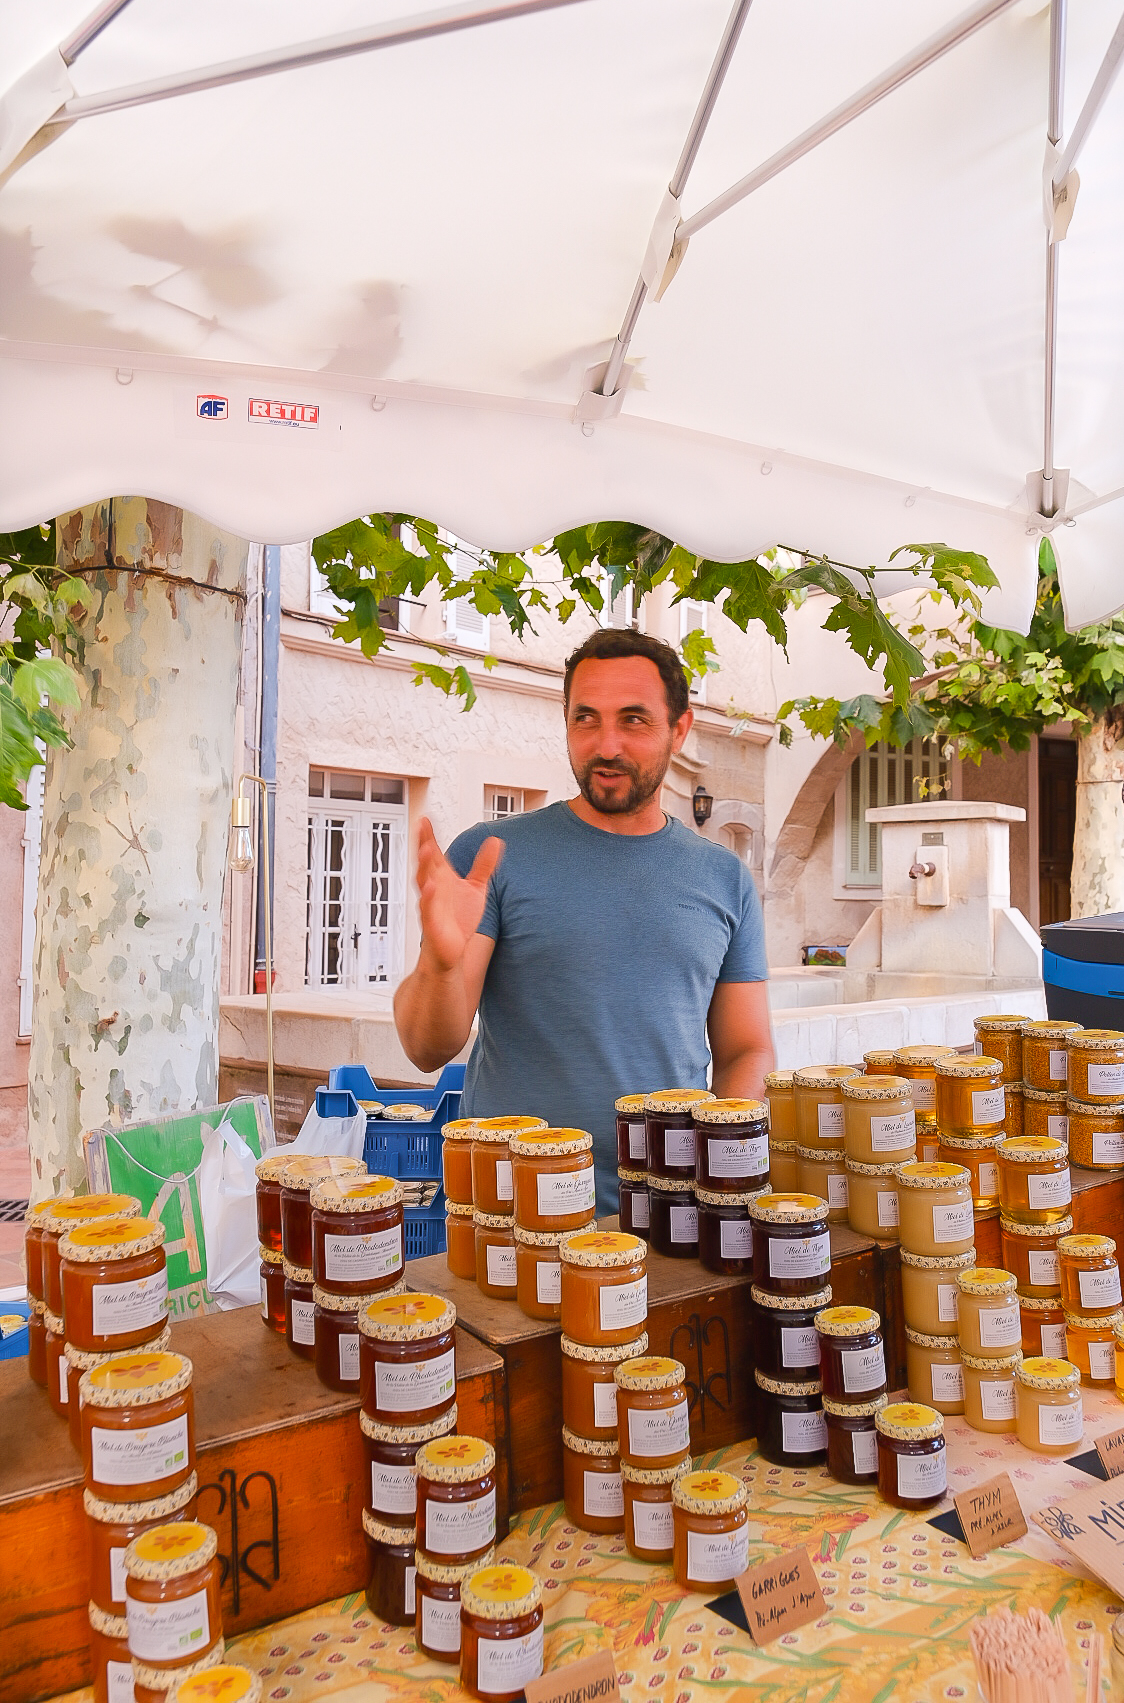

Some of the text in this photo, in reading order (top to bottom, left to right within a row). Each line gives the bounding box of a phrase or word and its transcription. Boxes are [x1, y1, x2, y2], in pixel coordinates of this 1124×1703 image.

[200, 400, 225, 417] AF
[252, 401, 316, 422] RETIF
[880, 1123, 896, 1132] Miel
[722, 1145, 738, 1154] Miel
[739, 1144, 746, 1153] de
[552, 1181, 566, 1190] Miel
[1039, 1181, 1053, 1190] Miel
[330, 1244, 346, 1254] Miel
[346, 1245, 354, 1253] de
[784, 1245, 801, 1256] Miel
[802, 1244, 809, 1254] de
[1090, 1278, 1105, 1287] Miel
[99, 1294, 118, 1305] Miel
[615, 1292, 630, 1303] Miel
[295, 1308, 309, 1318] Miel
[991, 1317, 1006, 1326] Miel
[798, 1334, 814, 1344] Miel
[859, 1356, 874, 1367] Miel
[381, 1372, 399, 1382] Miel
[399, 1373, 407, 1382] de
[992, 1389, 1008, 1398] Miel
[798, 1418, 815, 1428] Miel
[1051, 1413, 1068, 1423] Miel
[643, 1419, 659, 1429] Miel
[915, 1462, 932, 1472] Miel
[376, 1473, 393, 1483] Miel
[393, 1475, 401, 1483] de
[598, 1481, 614, 1491] Miel
[969, 1487, 1001, 1514] THYM
[431, 1511, 449, 1522] Miel
[449, 1514, 459, 1522] de
[648, 1511, 664, 1521] Miel
[704, 1543, 720, 1553] Miel
[752, 1565, 800, 1599] GARRIGUES
[429, 1608, 443, 1620] Miel
[484, 1648, 504, 1660] Miel
